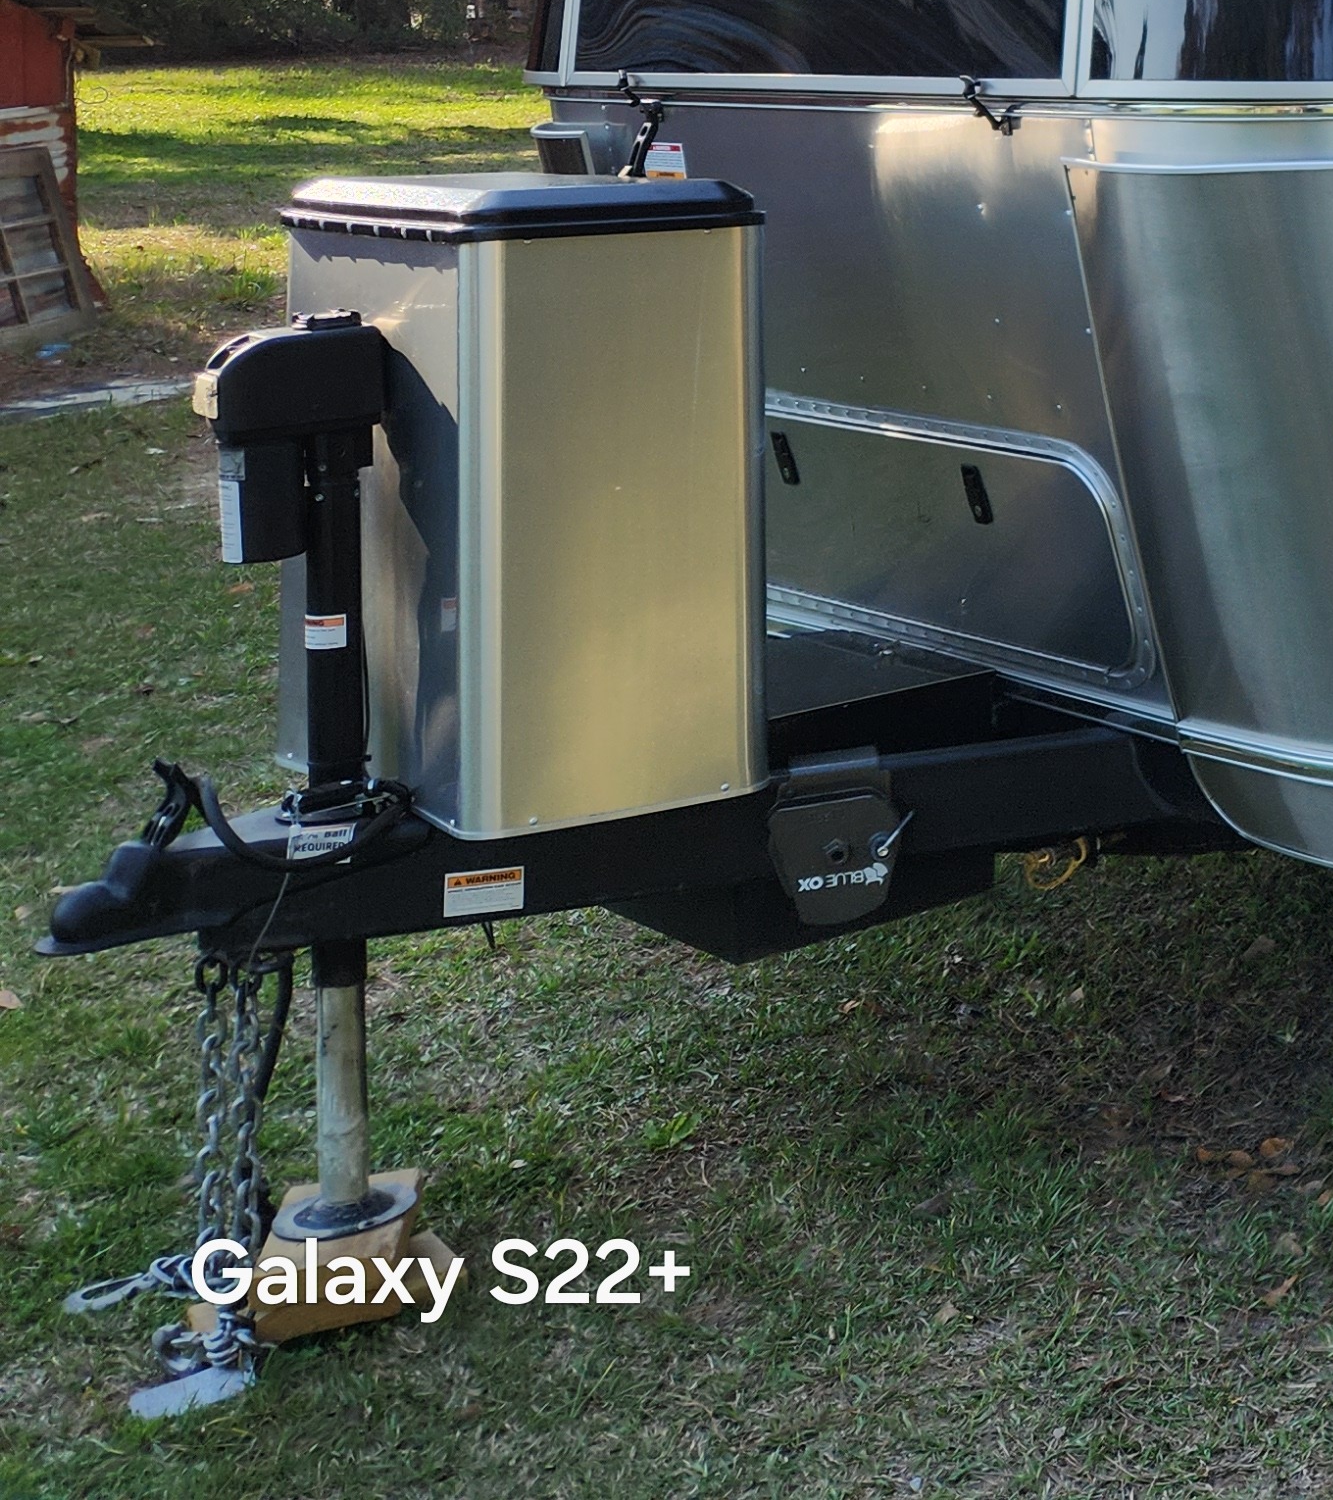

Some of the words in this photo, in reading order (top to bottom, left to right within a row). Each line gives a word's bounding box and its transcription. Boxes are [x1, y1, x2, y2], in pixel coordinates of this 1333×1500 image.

[465, 871, 516, 885] WARNING
[798, 876, 824, 892] OX
[824, 869, 865, 888] BLUE
